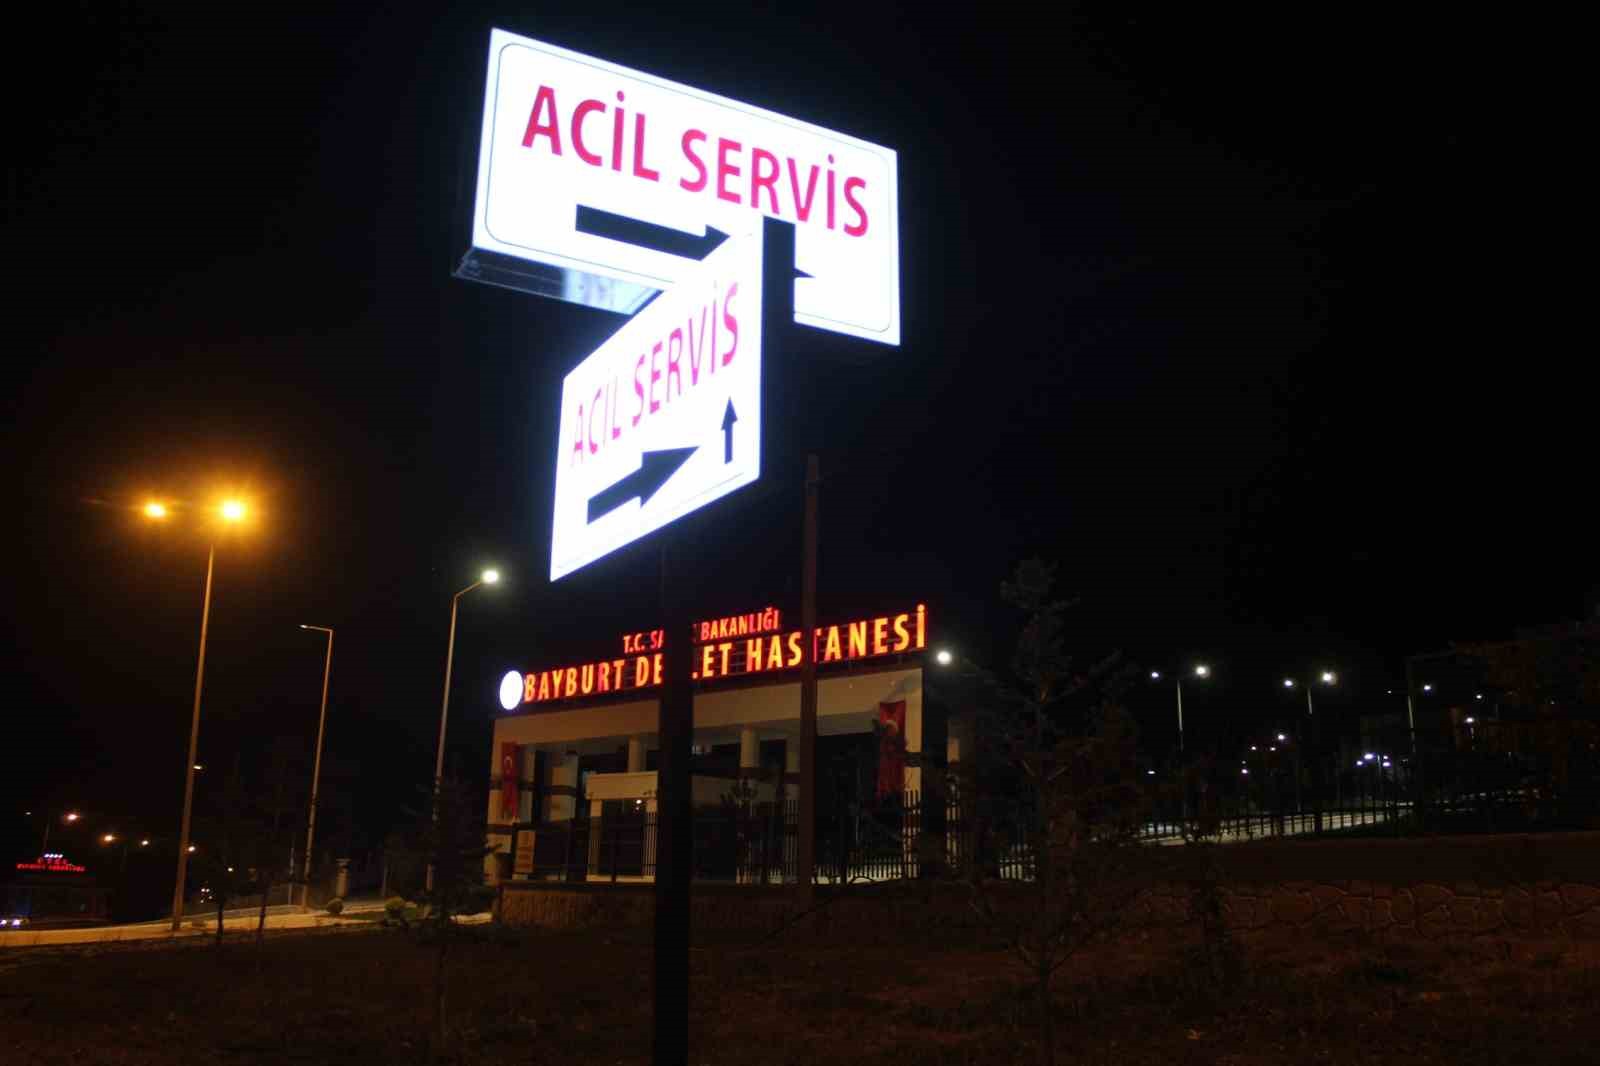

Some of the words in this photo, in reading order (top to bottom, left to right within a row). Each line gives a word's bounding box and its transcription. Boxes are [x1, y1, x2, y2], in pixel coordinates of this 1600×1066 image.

[520, 84, 660, 183] ACİL
[679, 128, 870, 238] SERVİS
[632, 281, 739, 428] SERVİS
[524, 659, 626, 702] BAYBURT
[635, 642, 734, 687] DEET
[623, 633, 646, 653] T.C.
[701, 606, 780, 641] BAKANLIĞI
